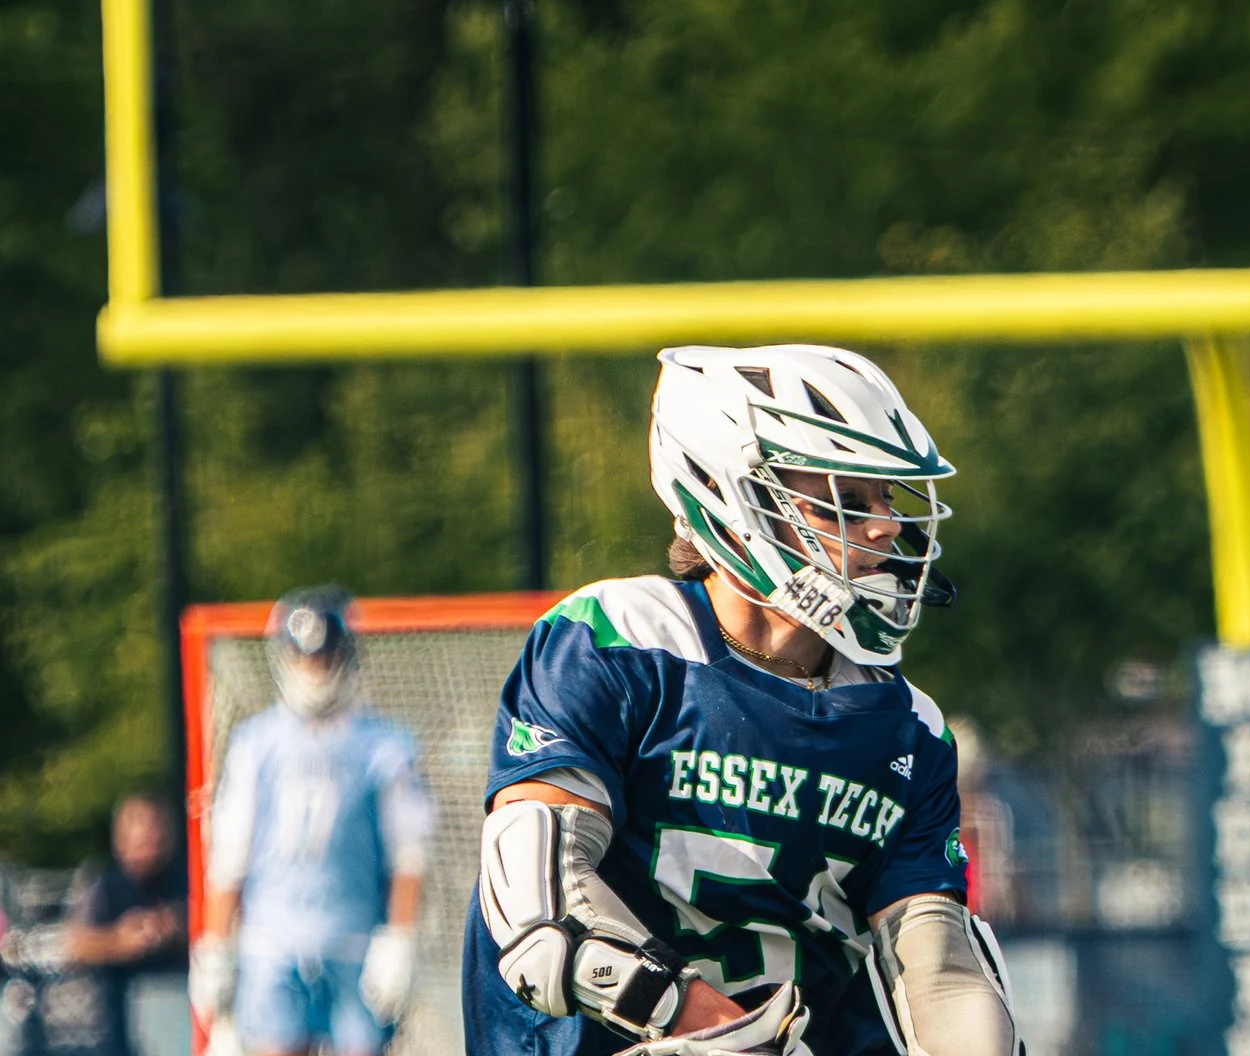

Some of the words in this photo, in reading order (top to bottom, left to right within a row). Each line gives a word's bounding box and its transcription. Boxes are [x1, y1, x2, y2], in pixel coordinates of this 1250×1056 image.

[784, 576, 842, 627] #BTB
[668, 750, 808, 820] ESSEX
[816, 773, 906, 848] TECH
[592, 965, 612, 978] 500
